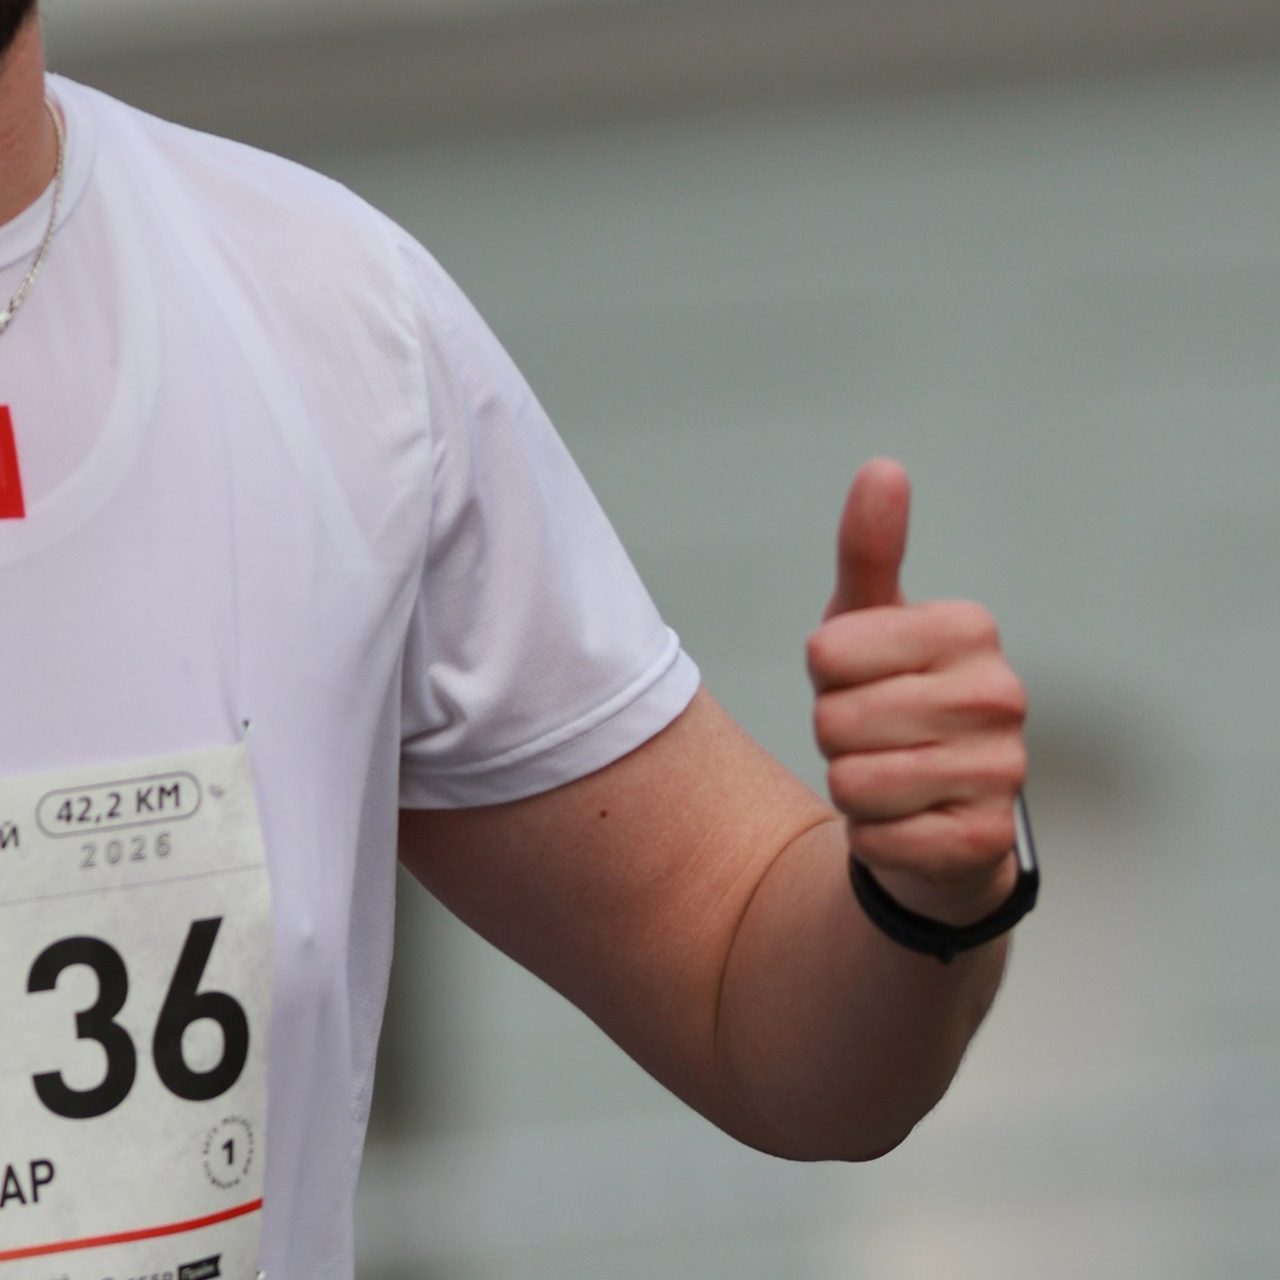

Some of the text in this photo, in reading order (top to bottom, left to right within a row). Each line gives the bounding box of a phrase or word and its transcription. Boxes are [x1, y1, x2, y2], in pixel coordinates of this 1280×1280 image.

[56, 792, 121, 825] 42,2
[79, 831, 172, 870] 2026
[222, 1137, 233, 1166] 1
